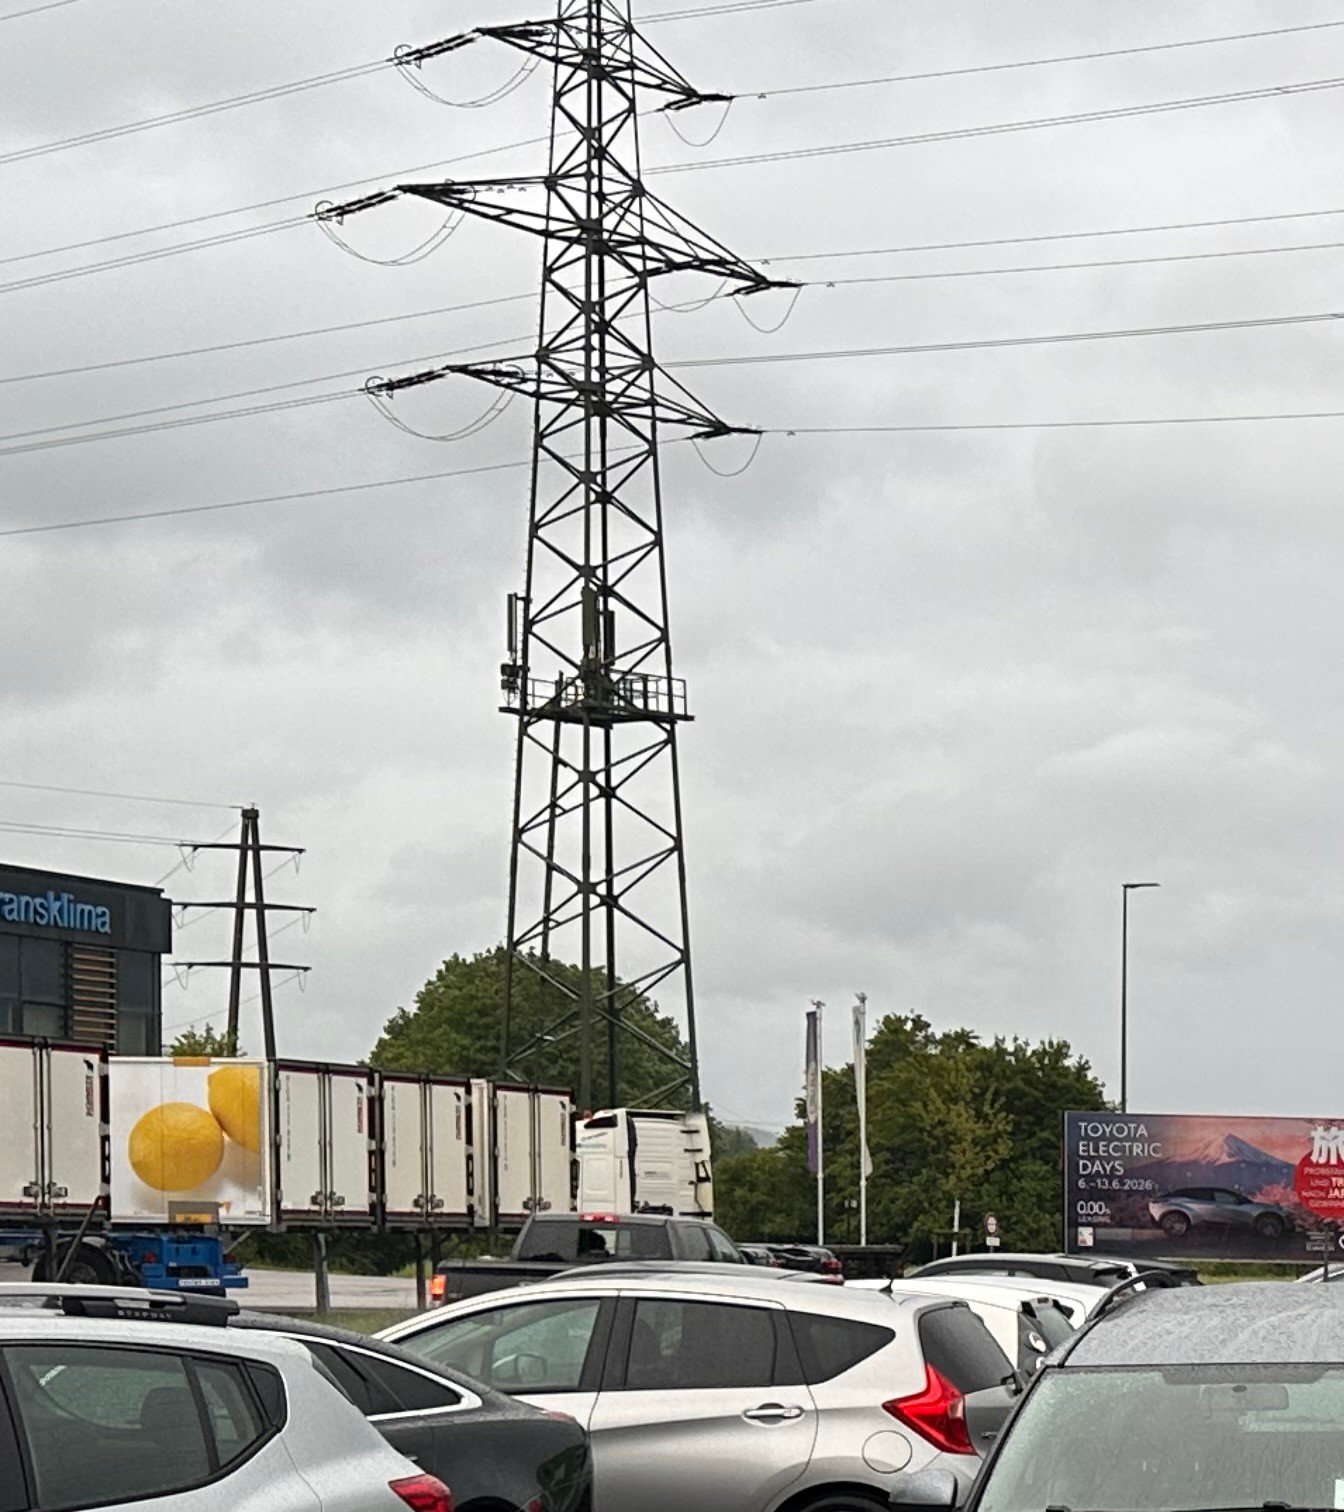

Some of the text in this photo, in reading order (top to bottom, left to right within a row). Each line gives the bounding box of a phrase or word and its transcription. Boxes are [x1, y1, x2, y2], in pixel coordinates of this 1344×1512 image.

[1078, 1122, 1148, 1138] TOYOTA
[1078, 1141, 1163, 1157] ELECTRIC
[1078, 1159, 1125, 1176] DAYS
